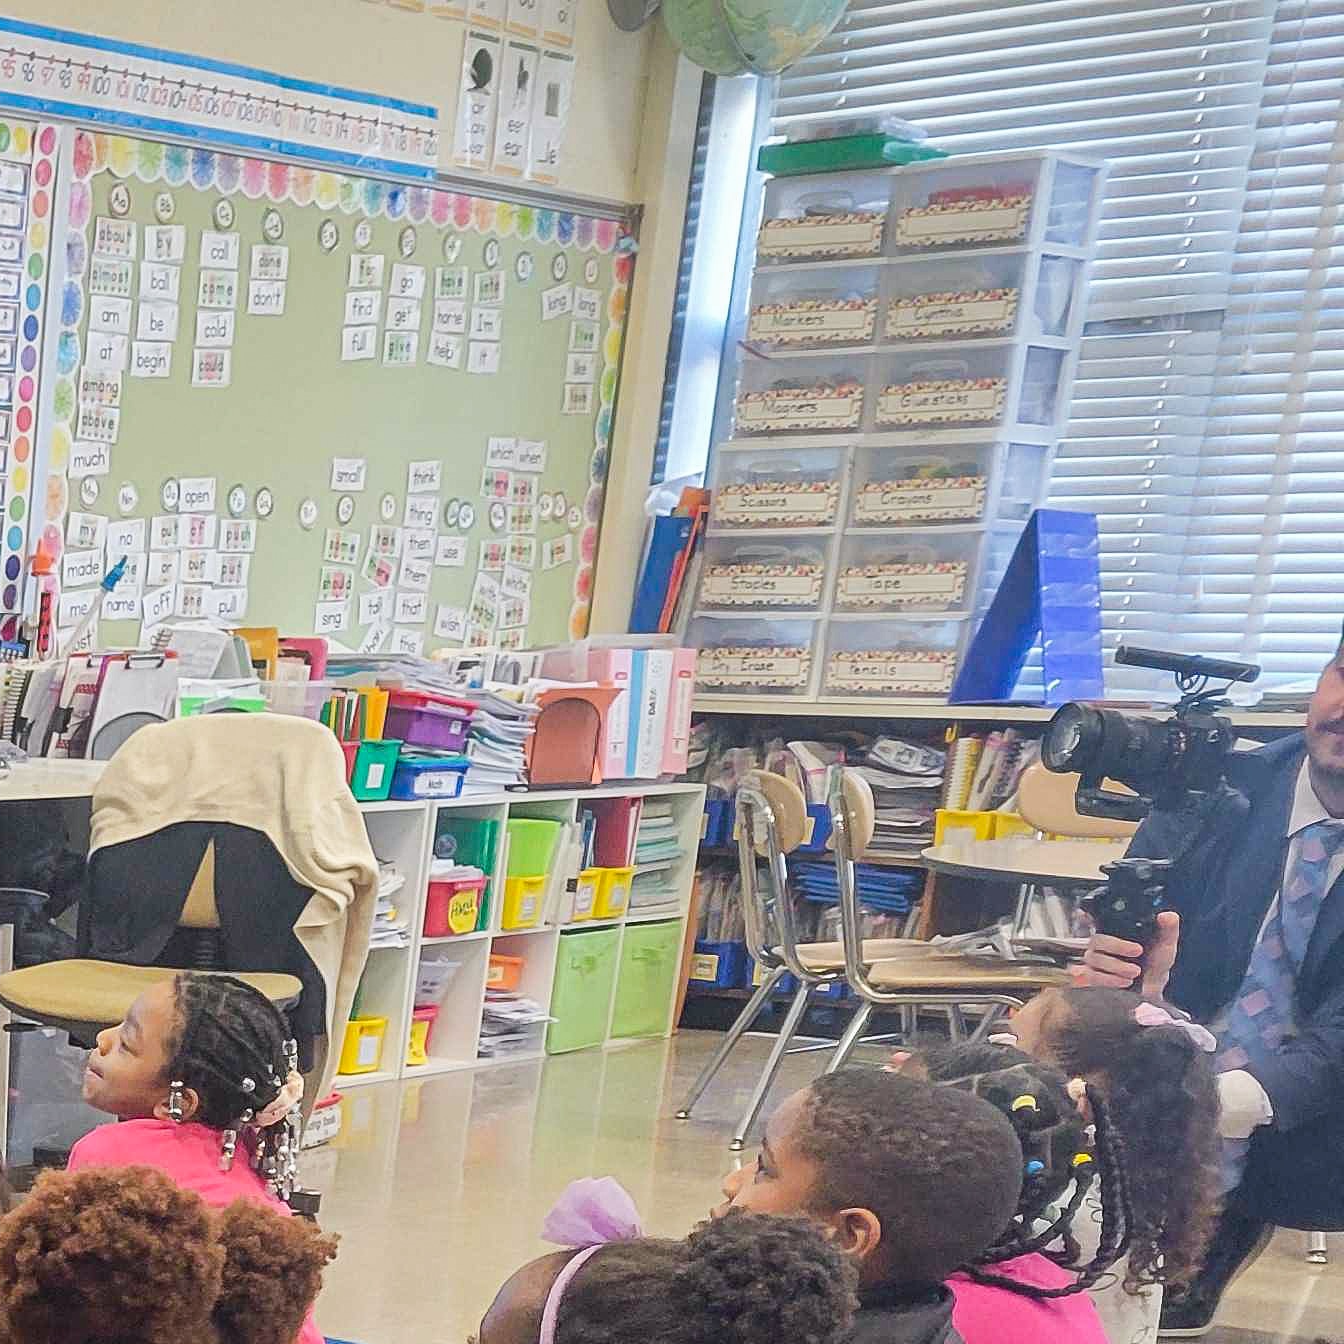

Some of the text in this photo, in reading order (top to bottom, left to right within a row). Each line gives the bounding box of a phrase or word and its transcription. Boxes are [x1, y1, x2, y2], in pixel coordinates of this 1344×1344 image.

[92, 76, 111, 95] 100
[98, 225, 132, 244] about
[155, 231, 172, 251] by
[92, 268, 129, 284] almost
[201, 280, 234, 298] come
[352, 299, 374, 316] find
[101, 311, 120, 324] am
[149, 315, 165, 332] be
[772, 314, 825, 327] Markers
[204, 320, 227, 338] cold
[136, 353, 167, 374] begin
[81, 379, 119, 398] among
[81, 413, 115, 431] above
[73, 451, 106, 470] much
[184, 488, 210, 508] open
[880, 490, 933, 506] Crayons
[79, 523, 97, 538] my
[119, 532, 133, 546] no
[67, 560, 100, 578] made
[730, 575, 776, 591] Staples
[864, 575, 902, 591] Tape
[69, 603, 89, 617] me
[106, 597, 136, 613] name
[218, 596, 238, 615] pull
[740, 660, 775, 673] Erase
[849, 664, 897, 678] Pencils
